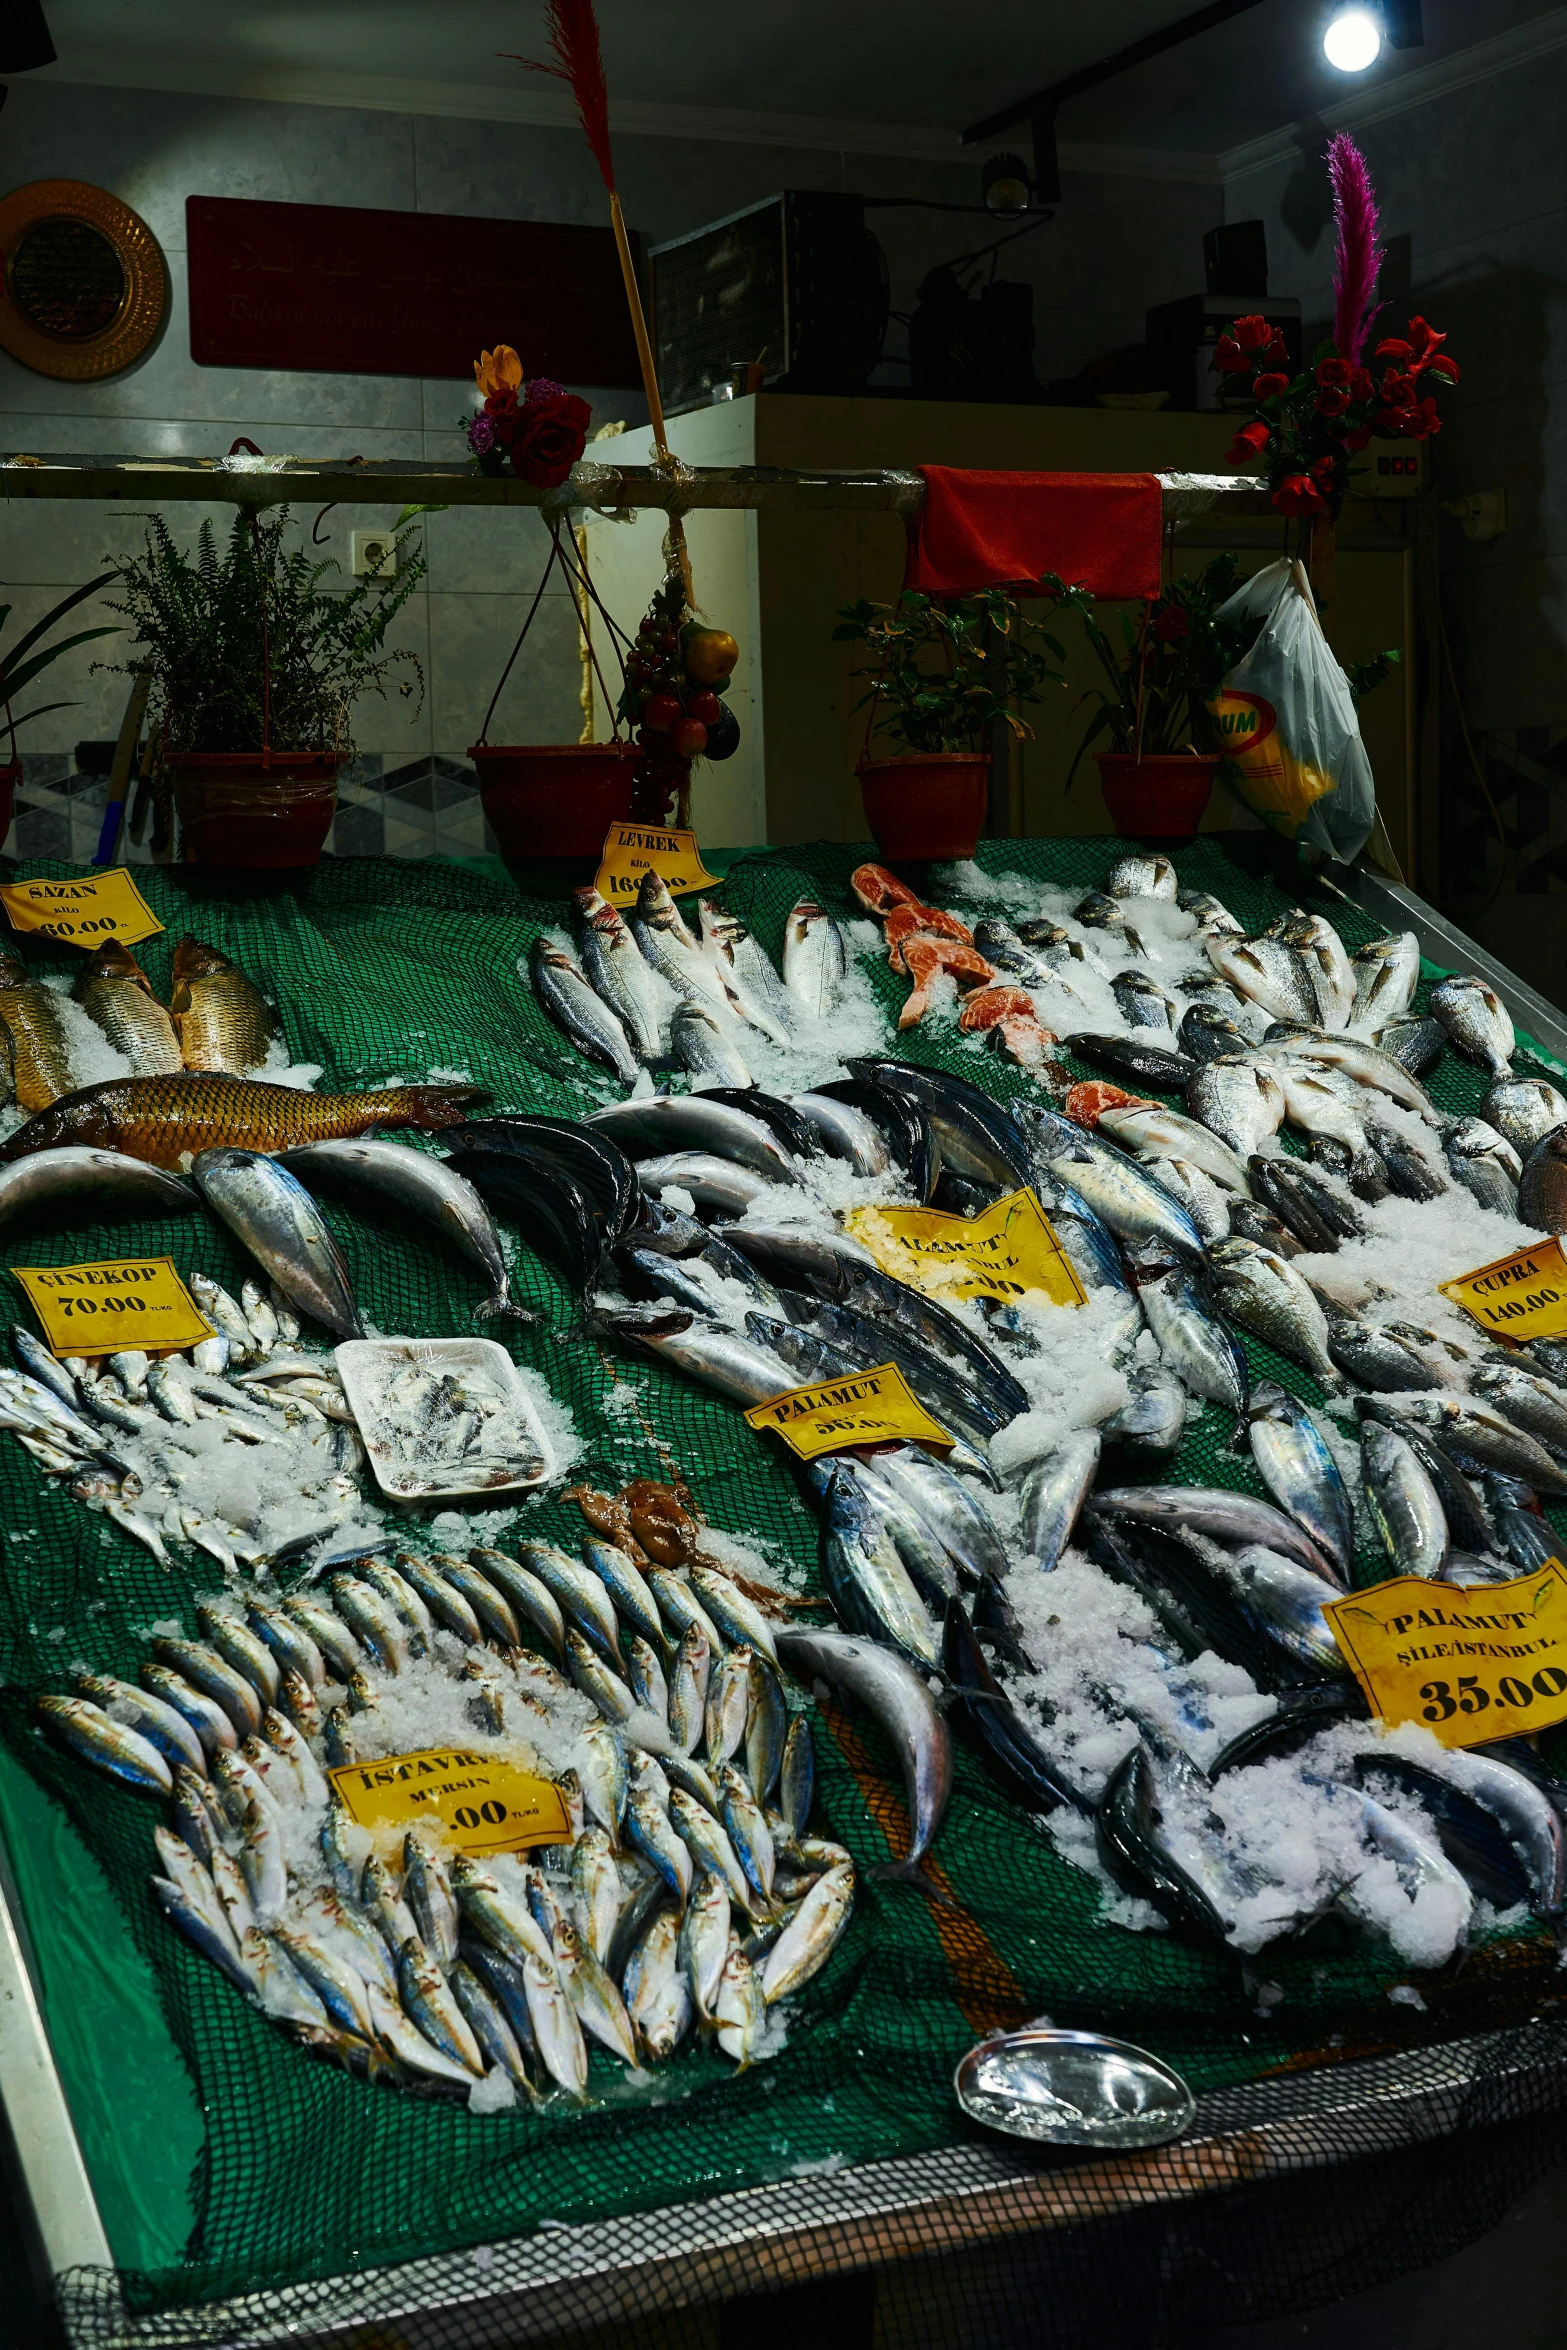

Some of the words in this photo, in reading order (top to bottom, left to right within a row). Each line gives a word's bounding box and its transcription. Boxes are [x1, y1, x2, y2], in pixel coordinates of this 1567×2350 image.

[617, 831, 681, 852] LEVREK
[630, 858, 650, 869] KİLO
[28, 884, 98, 900] SAZAN
[53, 905, 80, 914] KİLO
[40, 917, 117, 937] 60.00
[900, 1233, 1001, 1254] ALAMUT
[37, 1267, 157, 1289] ÇİNEKOP
[1472, 1259, 1541, 1298] ÇUPRA
[57, 1296, 147, 1317] 70.00
[1481, 1288, 1560, 1324] 140.00
[771, 1378, 883, 1424] PALAMUT
[1390, 1608, 1525, 1636] PALAMUT
[1419, 1666, 1567, 1723] 35.00
[358, 1753, 490, 1791] İSTAVR
[409, 1776, 491, 1805] MERSİN
[449, 1800, 507, 1831] .00
